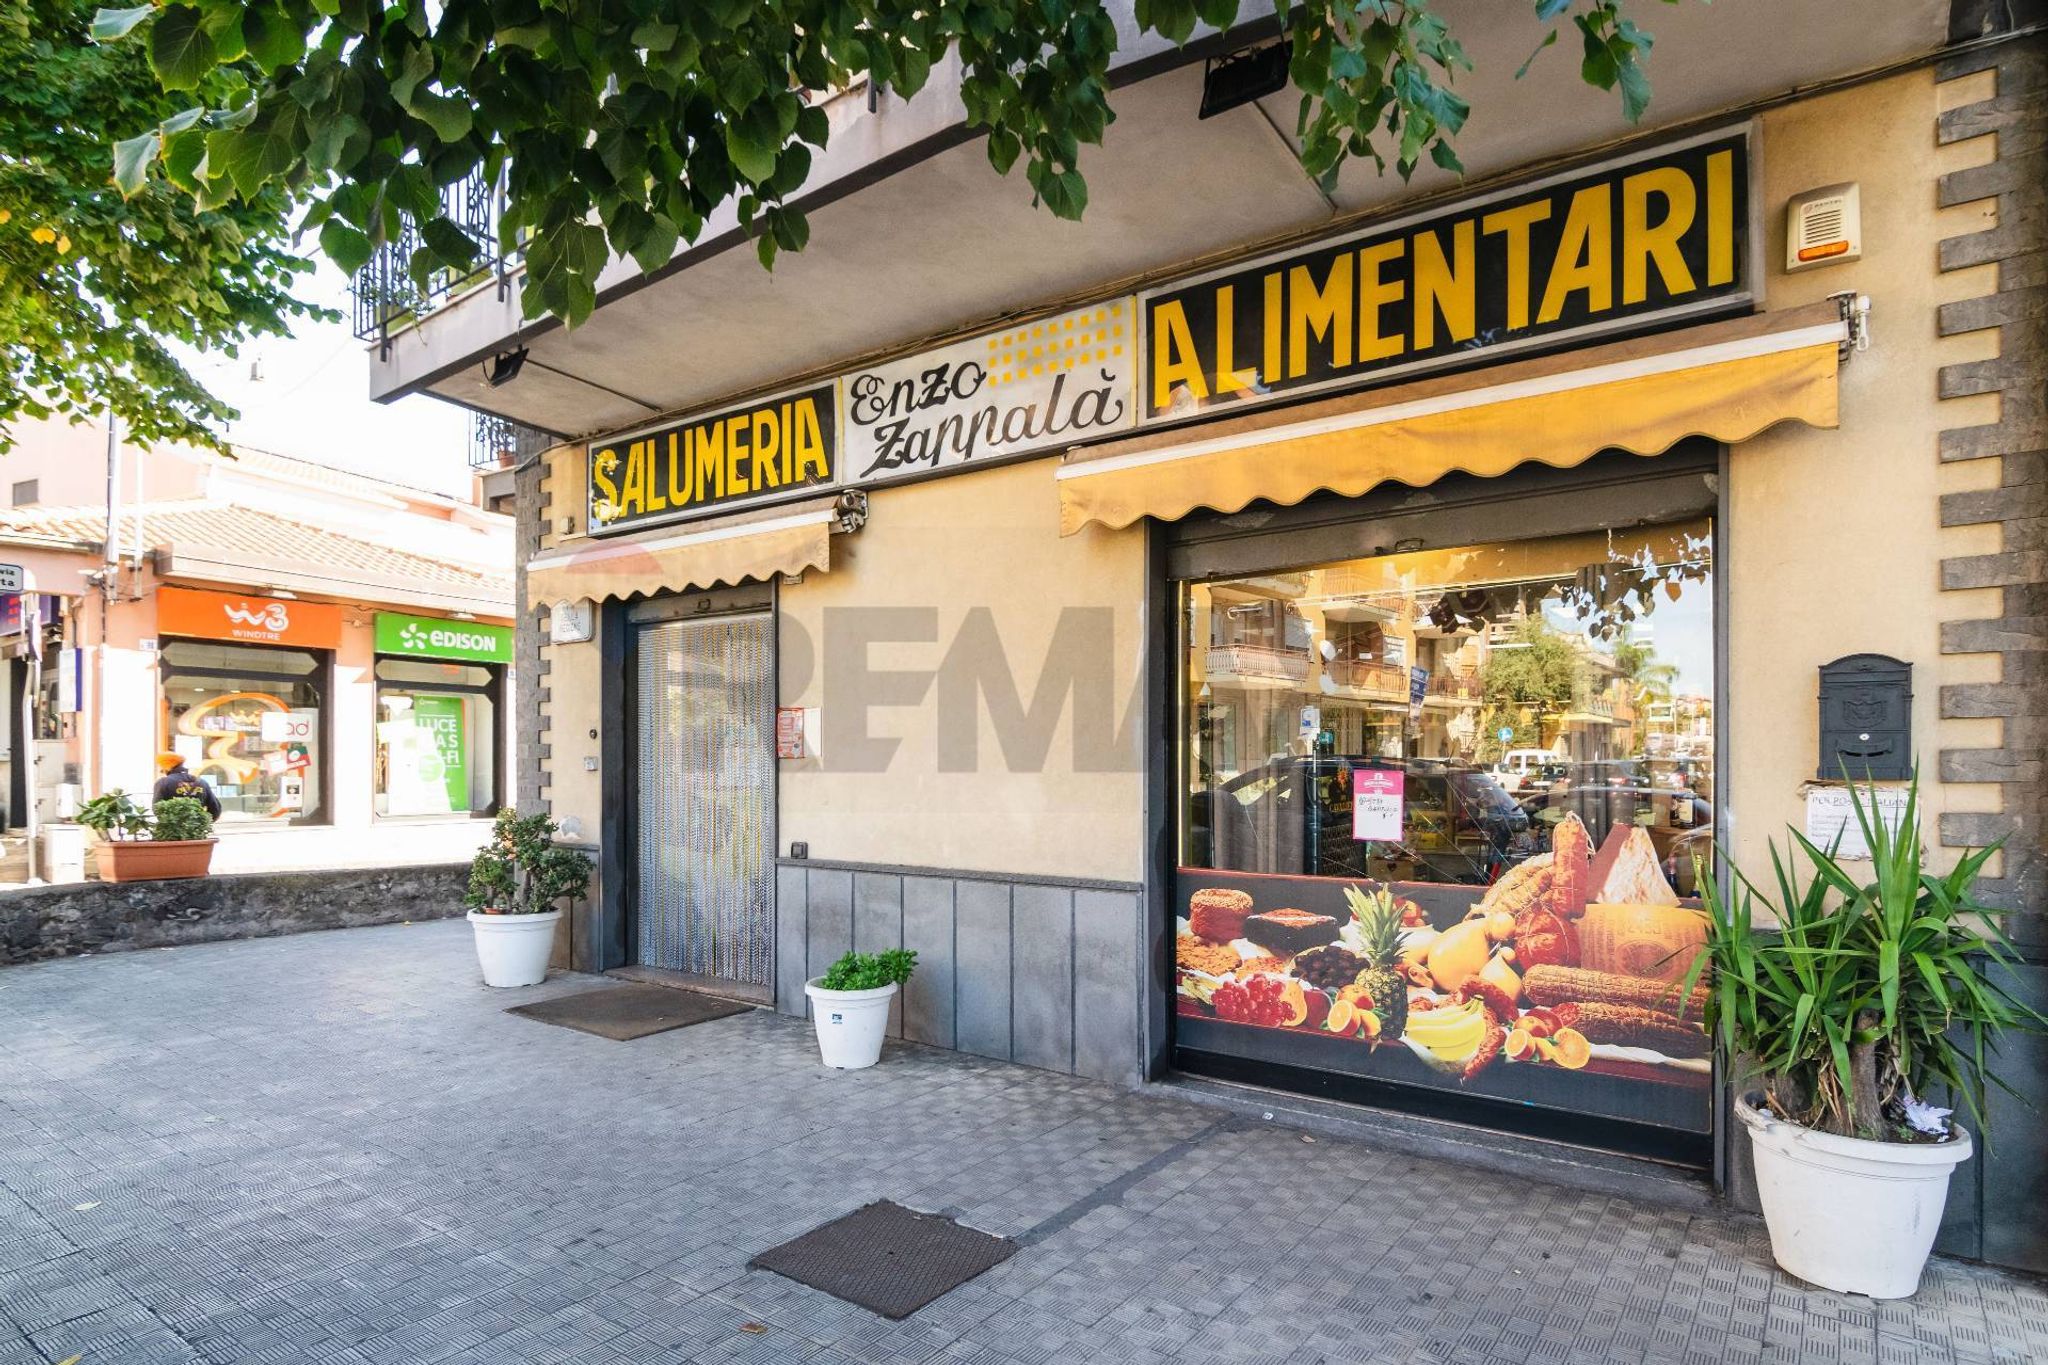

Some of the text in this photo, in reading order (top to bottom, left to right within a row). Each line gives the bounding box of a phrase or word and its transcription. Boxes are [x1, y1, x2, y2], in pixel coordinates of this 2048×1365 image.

[1154, 149, 1734, 408] ALIMENTARI
[850, 361, 987, 426] Enzo
[859, 368, 1124, 479] Zappalà
[593, 397, 829, 522] SALUMERIA
[232, 629, 281, 641] WINDTRE
